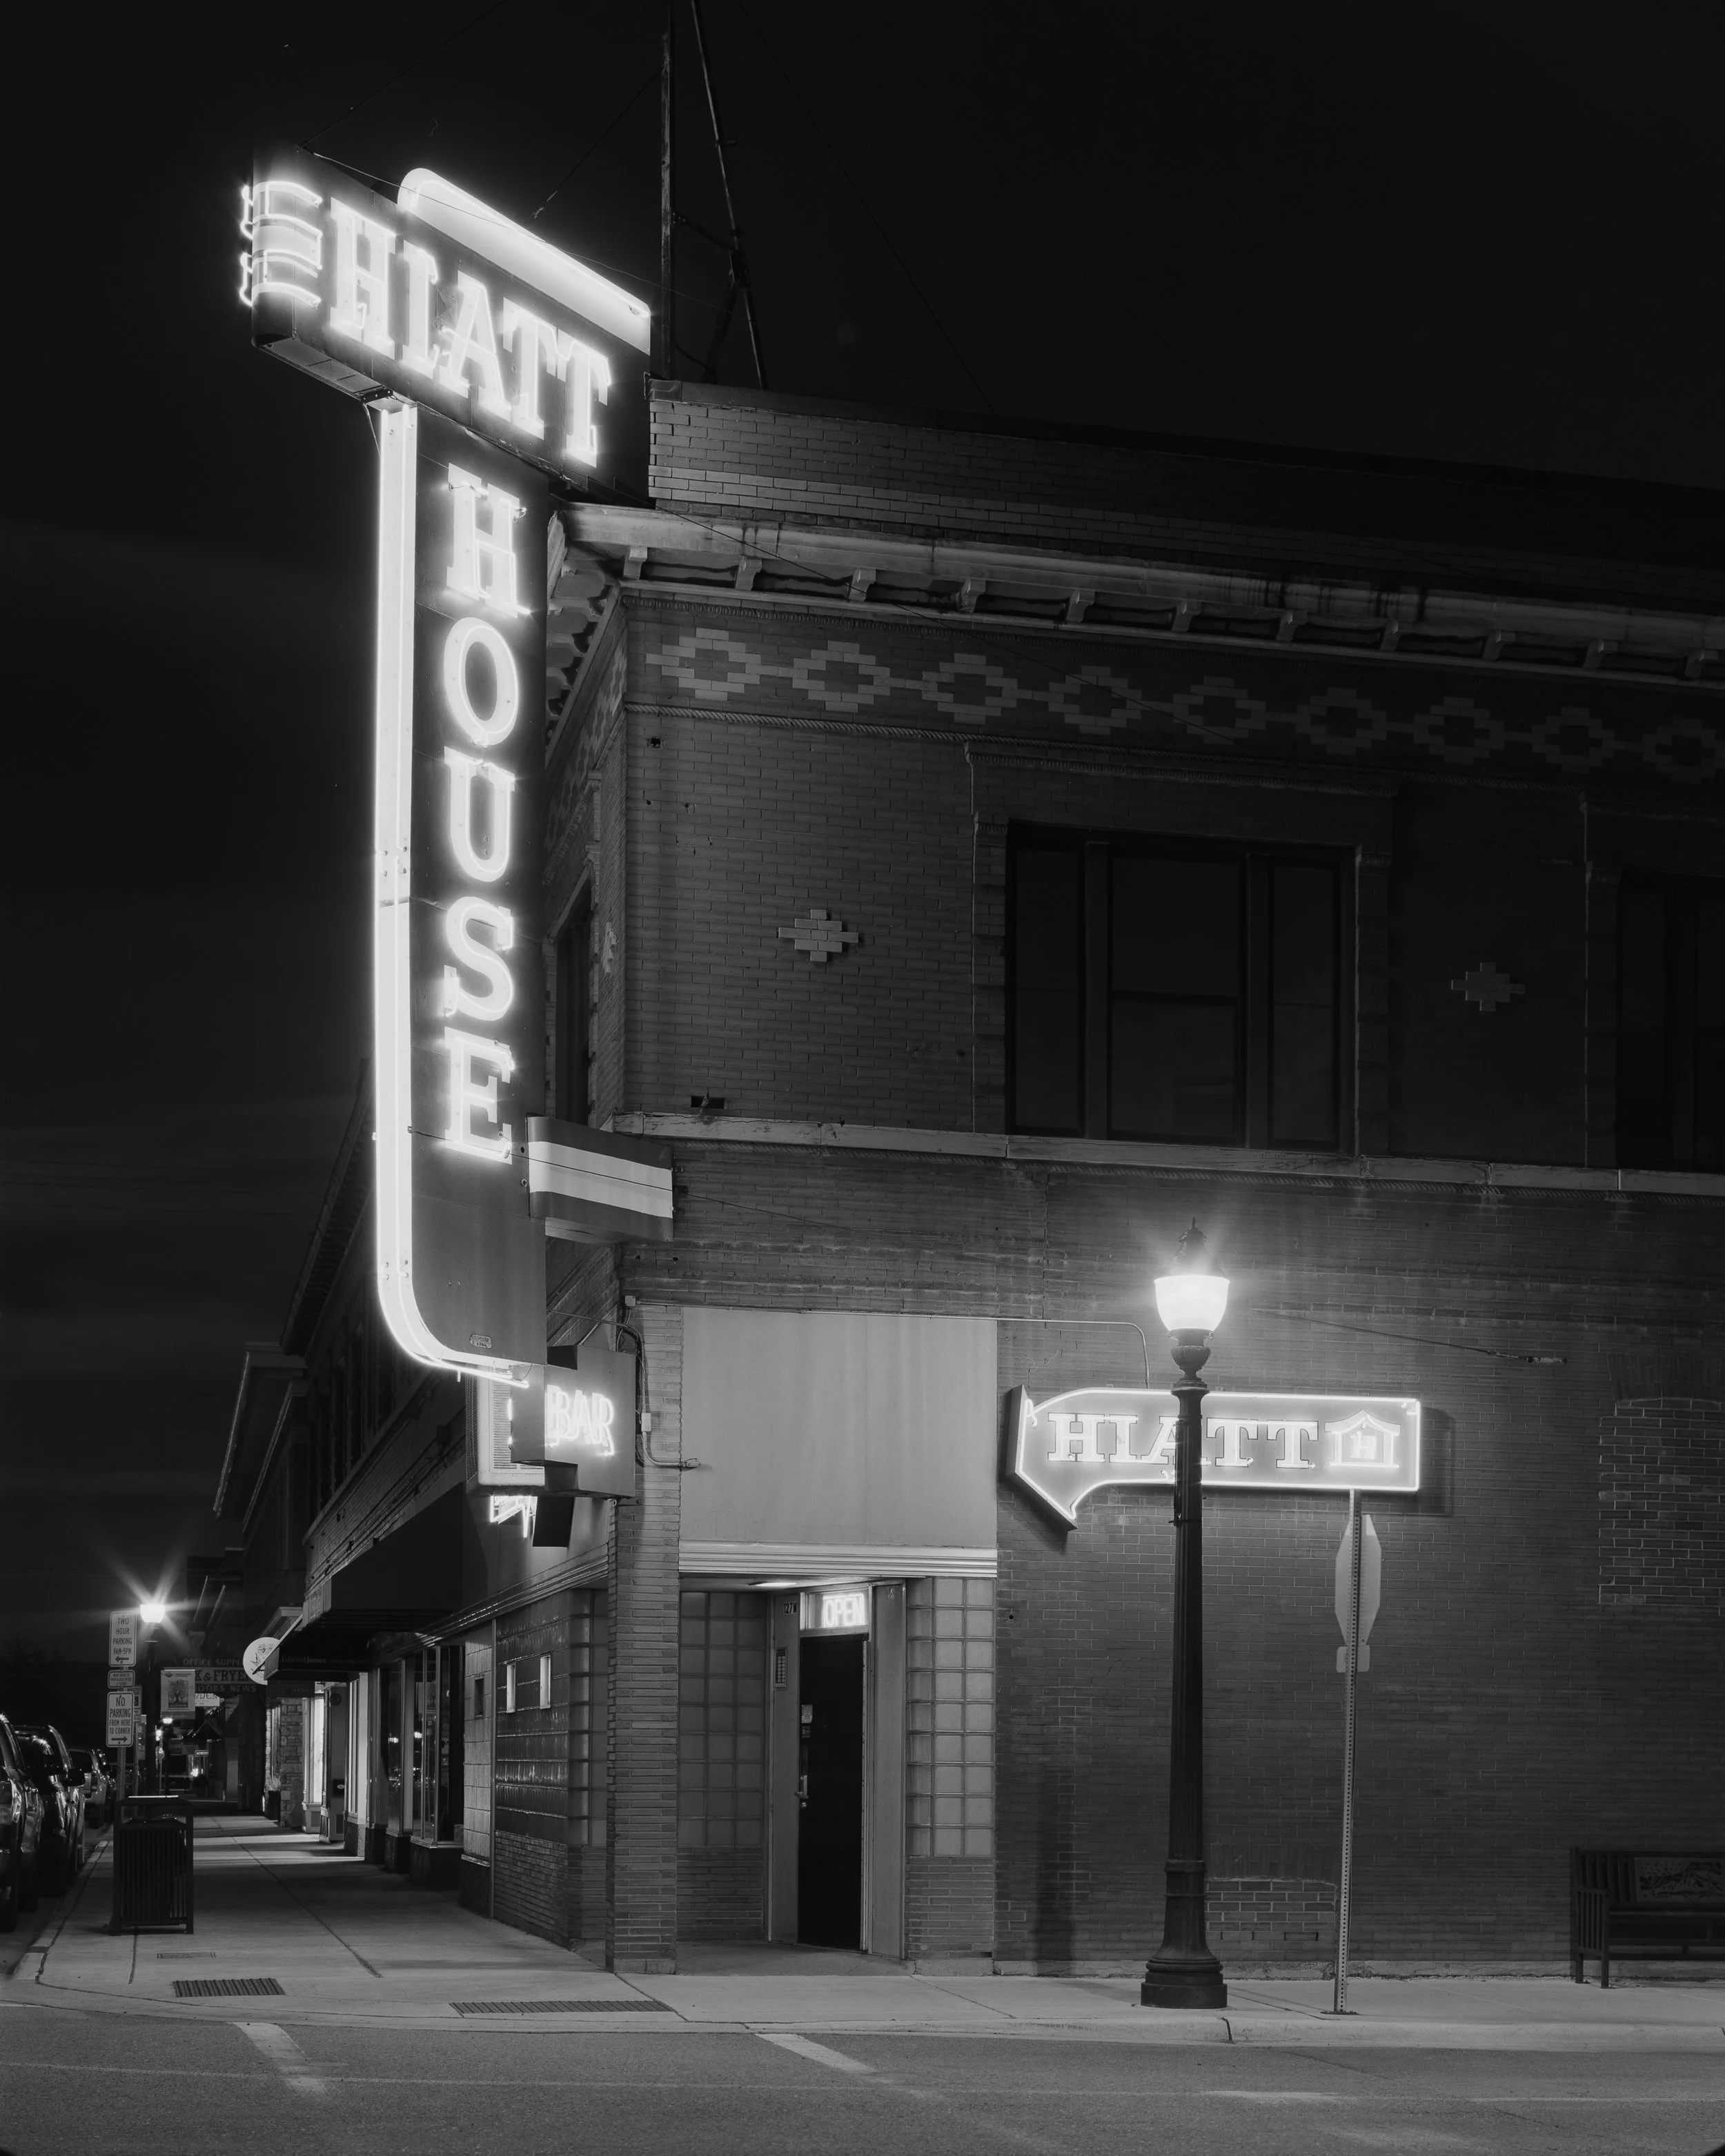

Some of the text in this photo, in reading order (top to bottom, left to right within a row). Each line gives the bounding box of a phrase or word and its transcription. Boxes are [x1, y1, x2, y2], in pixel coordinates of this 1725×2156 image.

[330, 196, 611, 468] HIATT
[444, 463, 526, 1165] HOUSE
[544, 1384, 615, 1455] BAR
[1047, 1412, 1319, 1470] HIATT
[825, 1597, 865, 1627] OPEN
[112, 1637, 132, 1645] PARKING
[182, 1658, 241, 1666] OFFICE SUPPL
[213, 1669, 248, 1681] FRYE
[230, 1685, 257, 1693] NEWS
[116, 1697, 126, 1707] NO
[195, 1692, 217, 1701] RDEN
[110, 1708, 131, 1718] PARKING
